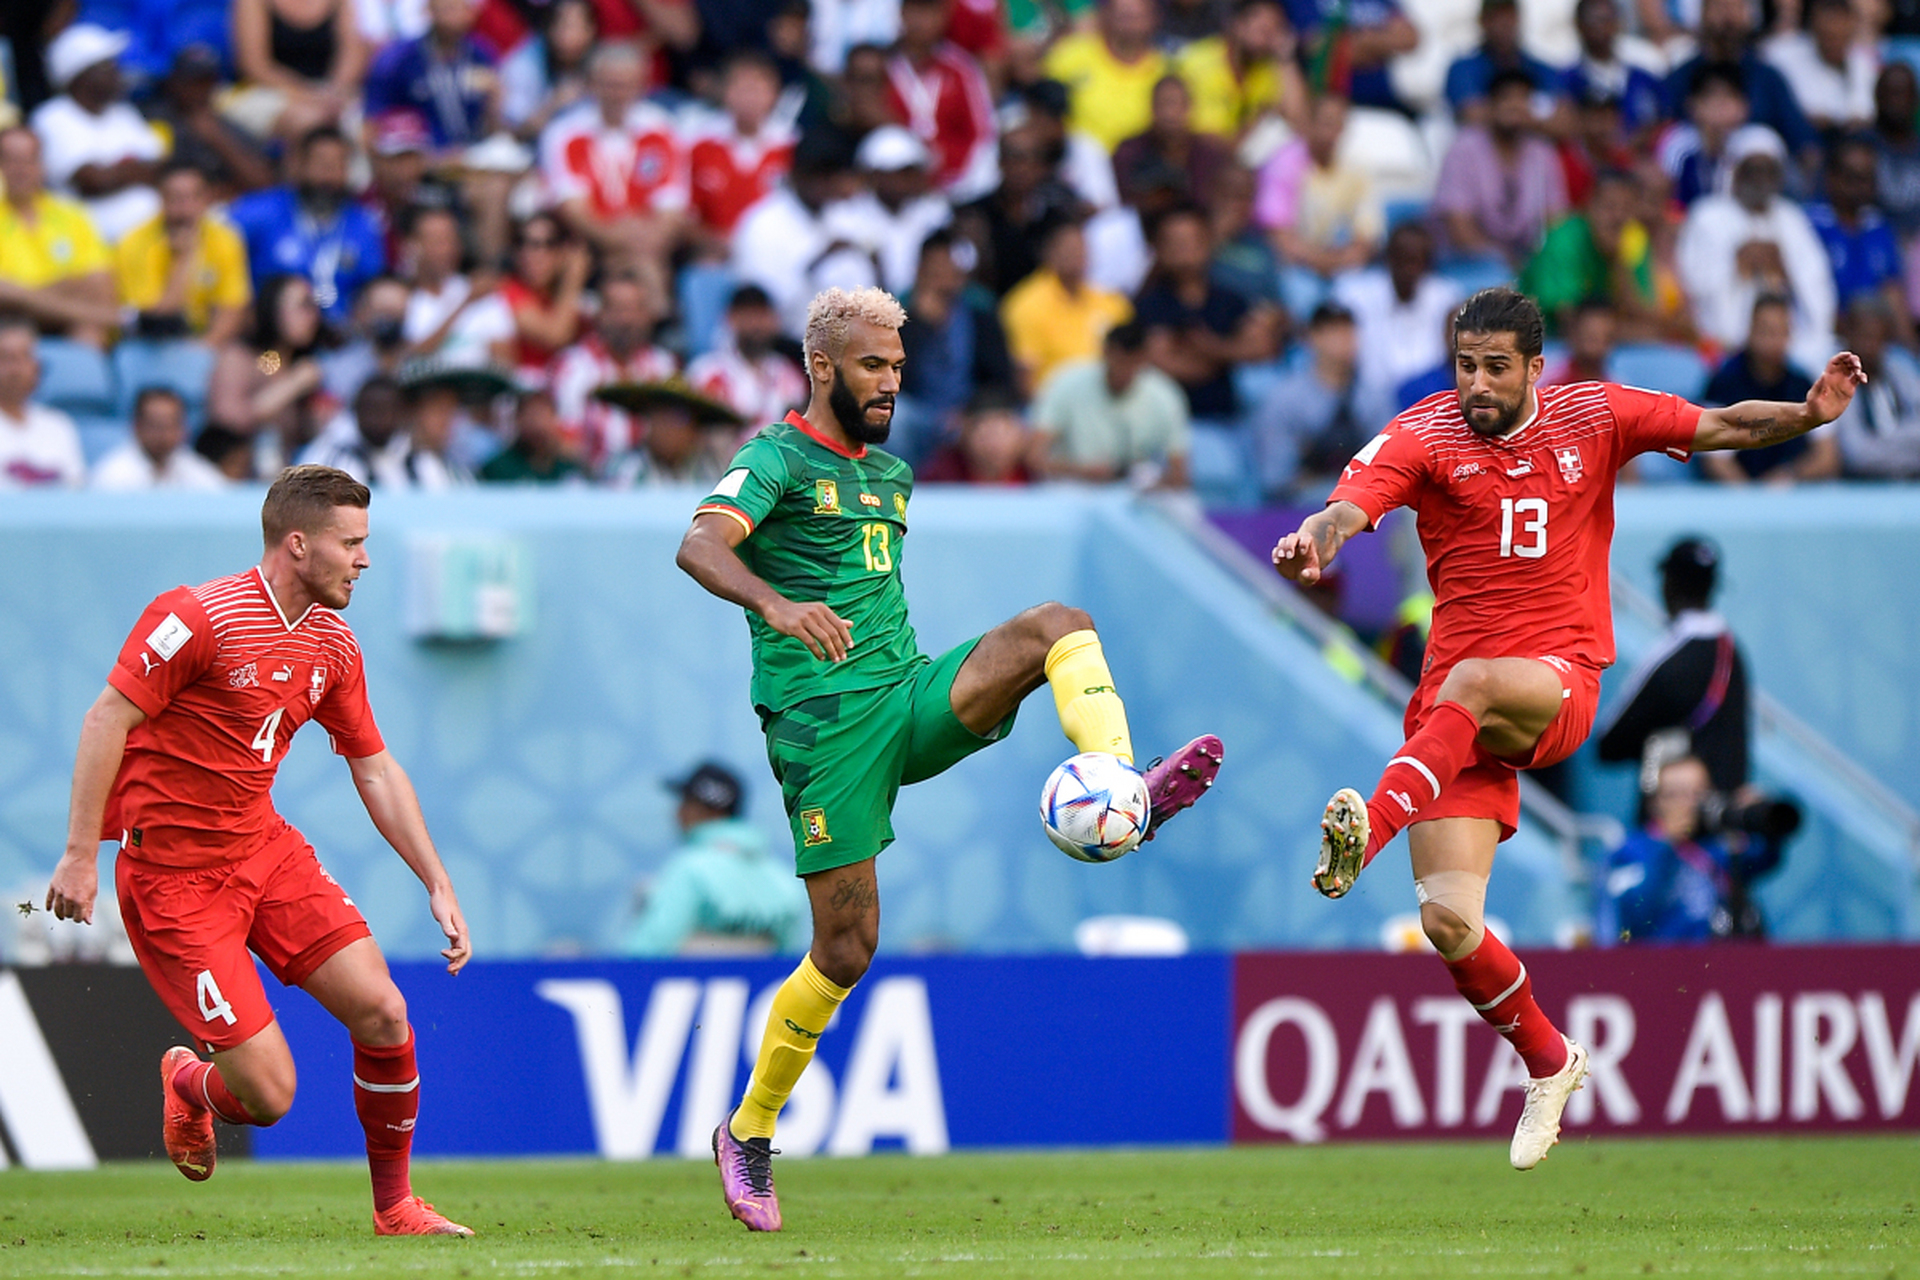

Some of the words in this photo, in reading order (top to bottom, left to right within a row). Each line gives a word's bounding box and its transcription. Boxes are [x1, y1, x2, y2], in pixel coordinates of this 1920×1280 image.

[861, 523, 892, 572] 13
[1500, 498, 1548, 558] 13
[251, 706, 287, 762] 4
[197, 969, 238, 1026] 4
